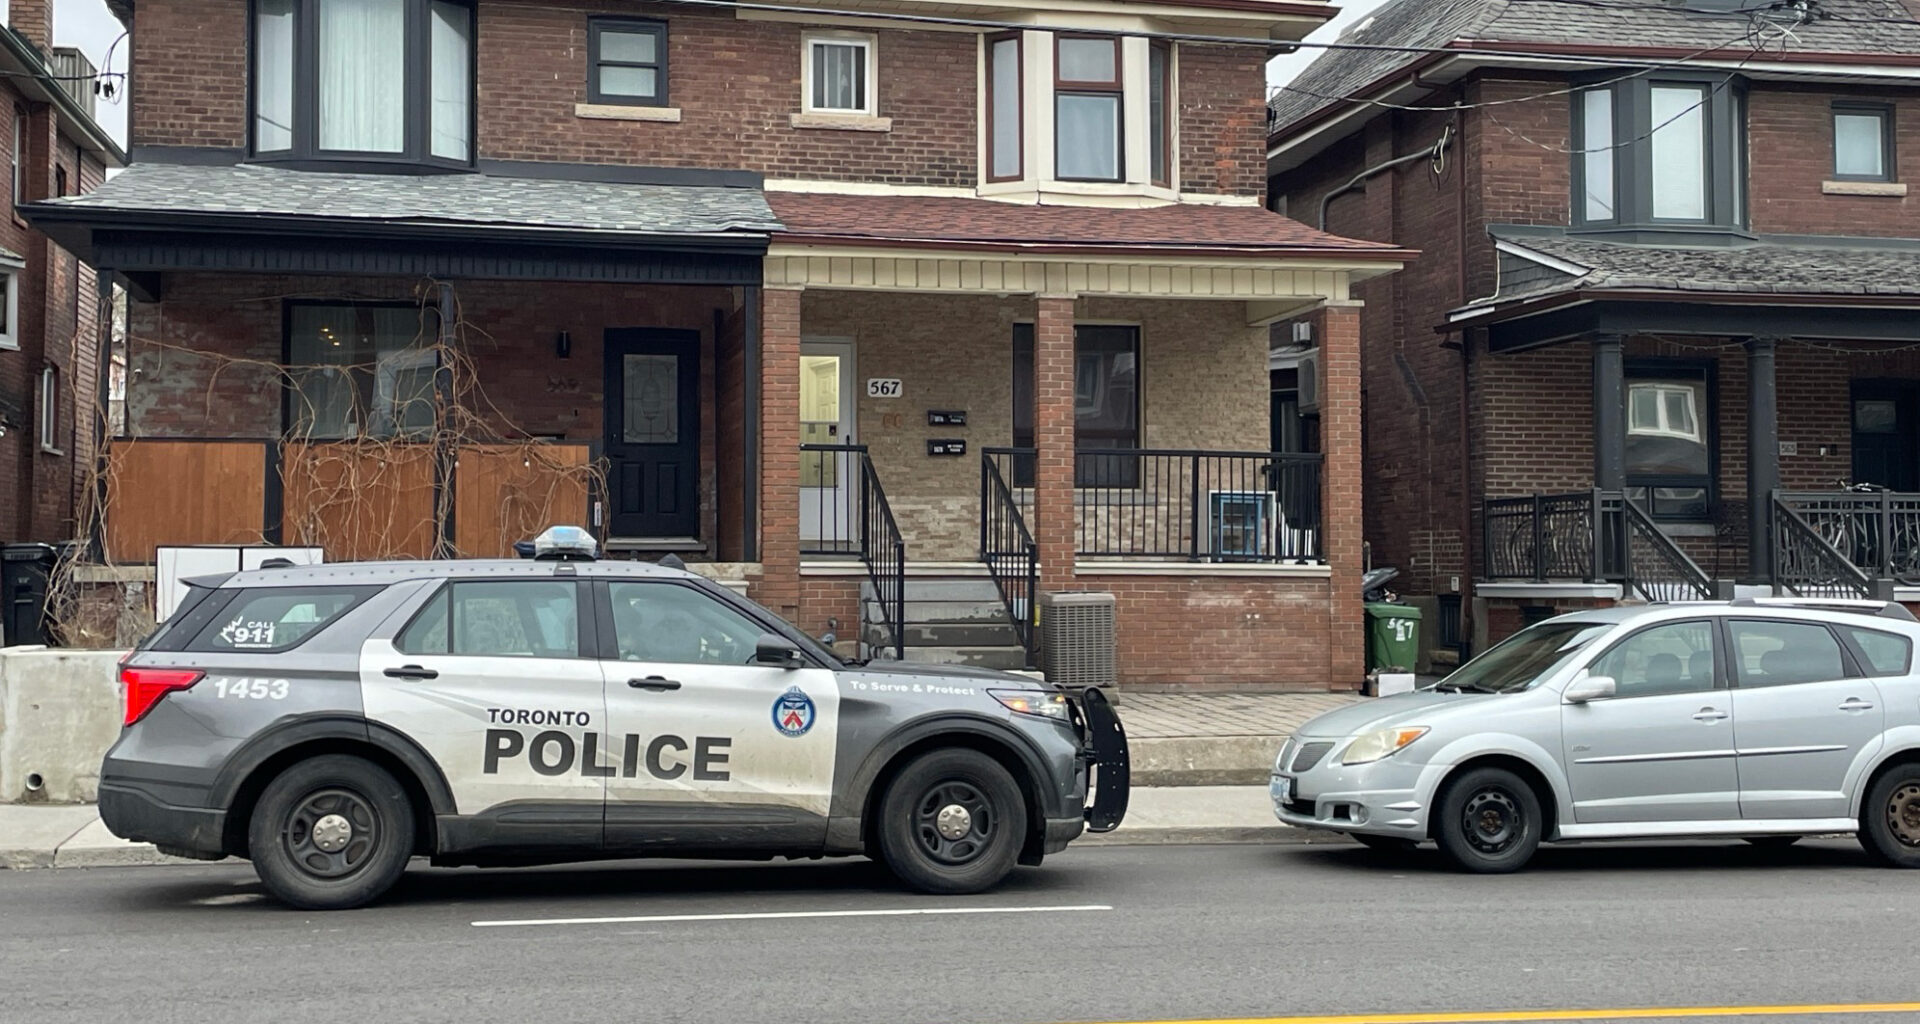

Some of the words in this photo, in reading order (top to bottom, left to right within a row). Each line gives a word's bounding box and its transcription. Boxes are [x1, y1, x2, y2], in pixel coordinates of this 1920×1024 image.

[870, 381, 900, 396] 567
[247, 621, 276, 629] CALL
[233, 628, 274, 643] 9-1-1
[215, 678, 290, 700] 1453
[850, 680, 867, 690] To
[870, 681, 909, 692] Serve
[912, 683, 923, 693] &
[926, 684, 975, 696] Protect
[487, 708, 591, 726] TORONTO
[483, 728, 732, 782] POLICE
